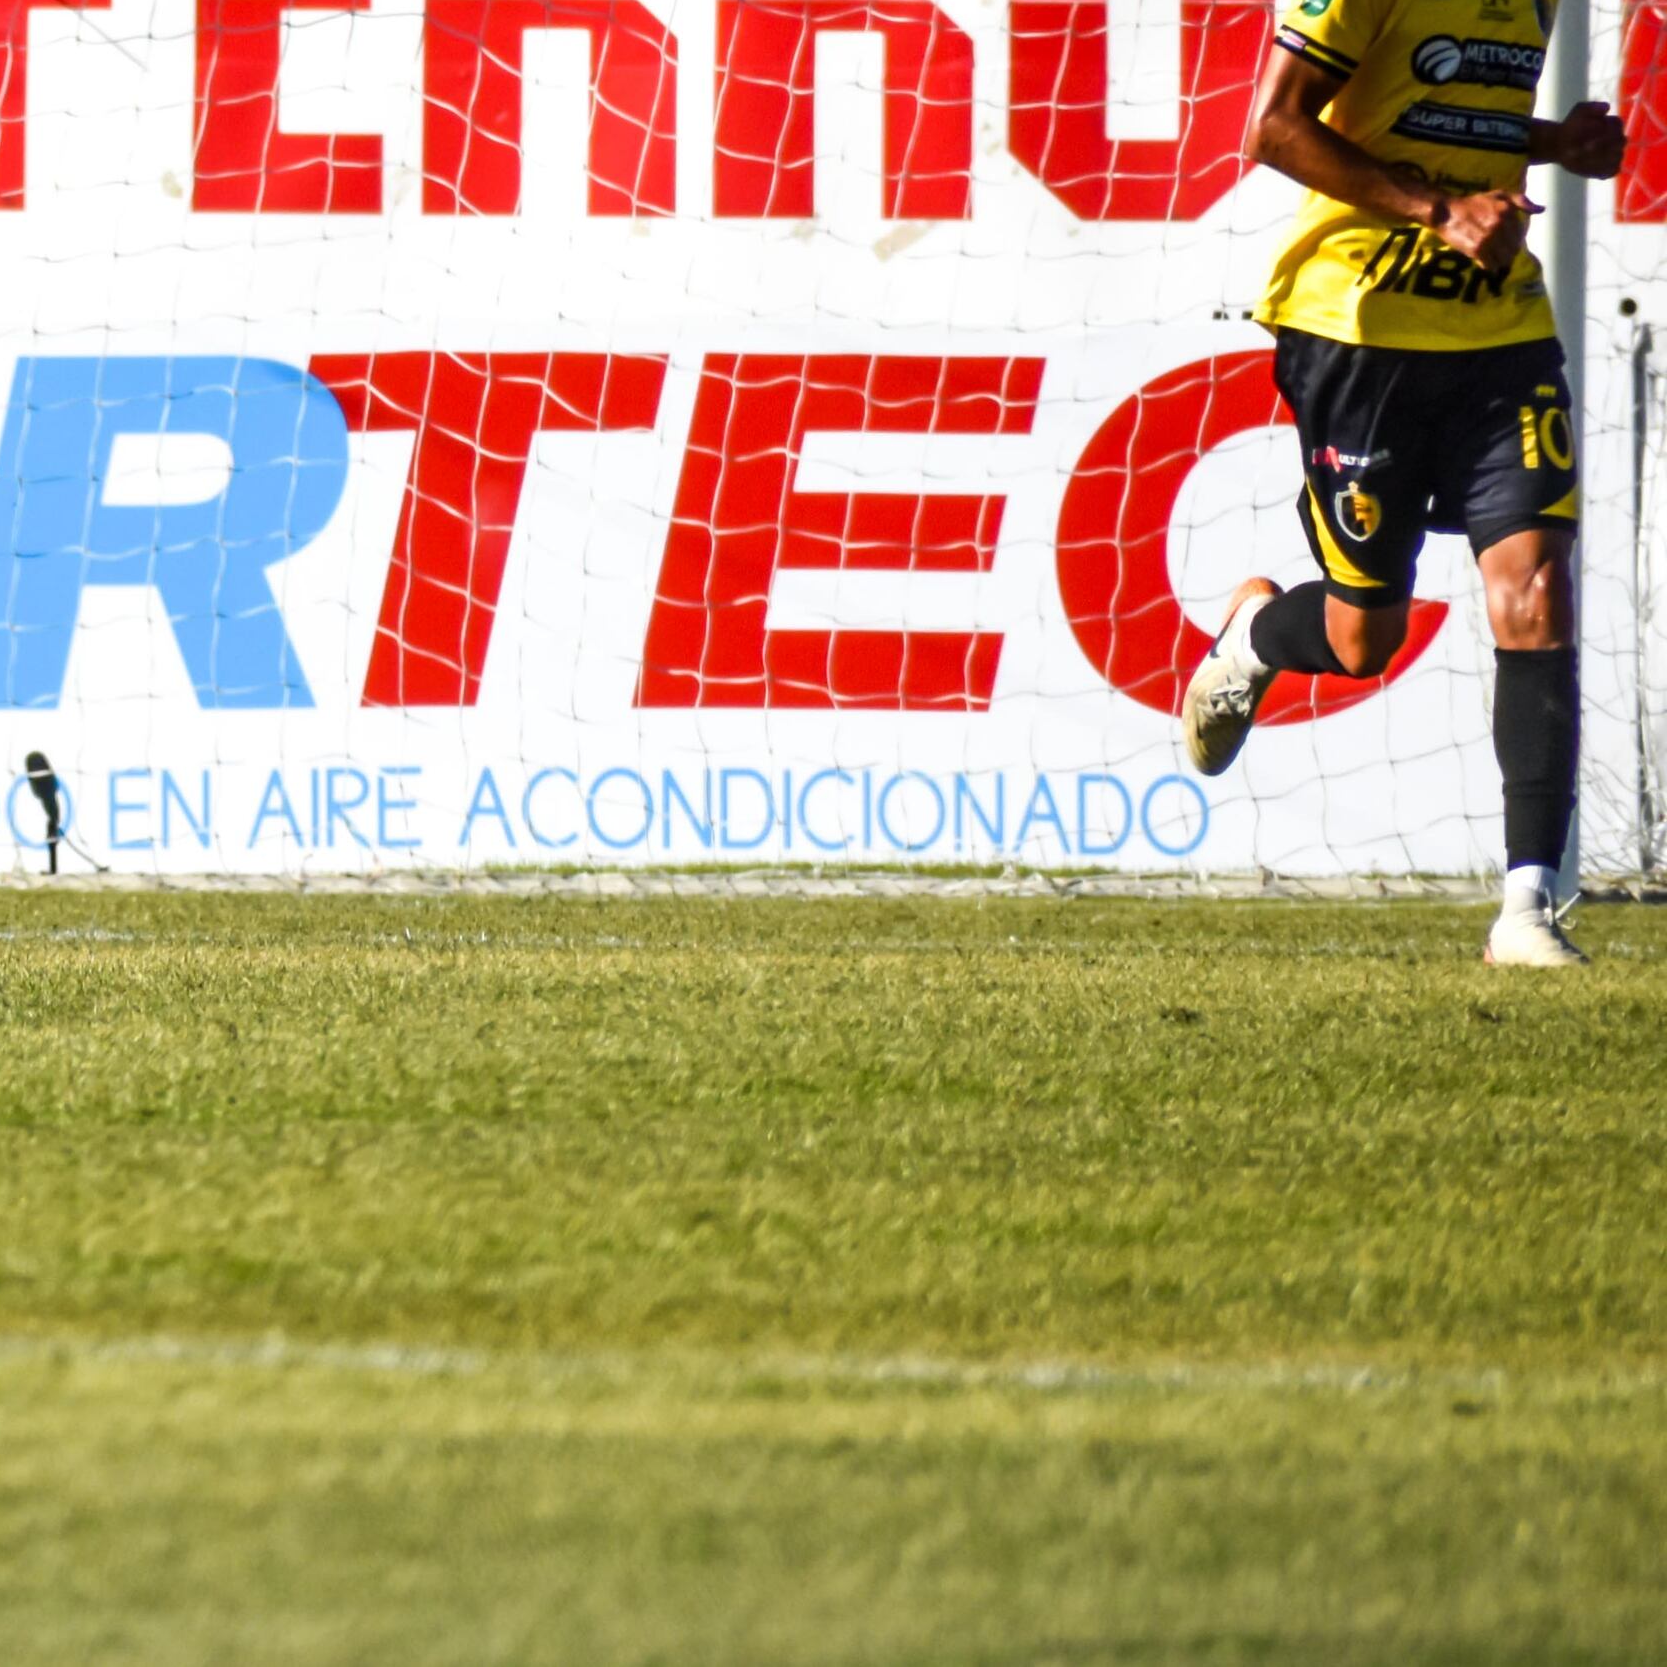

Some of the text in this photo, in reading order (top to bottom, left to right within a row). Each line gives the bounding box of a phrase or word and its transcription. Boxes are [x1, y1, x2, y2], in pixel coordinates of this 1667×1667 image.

[1519, 405, 1574, 471] 10
[111, 768, 209, 850] EN
[245, 766, 423, 852] AIRE
[456, 767, 1211, 857] ACONDICIONADO
